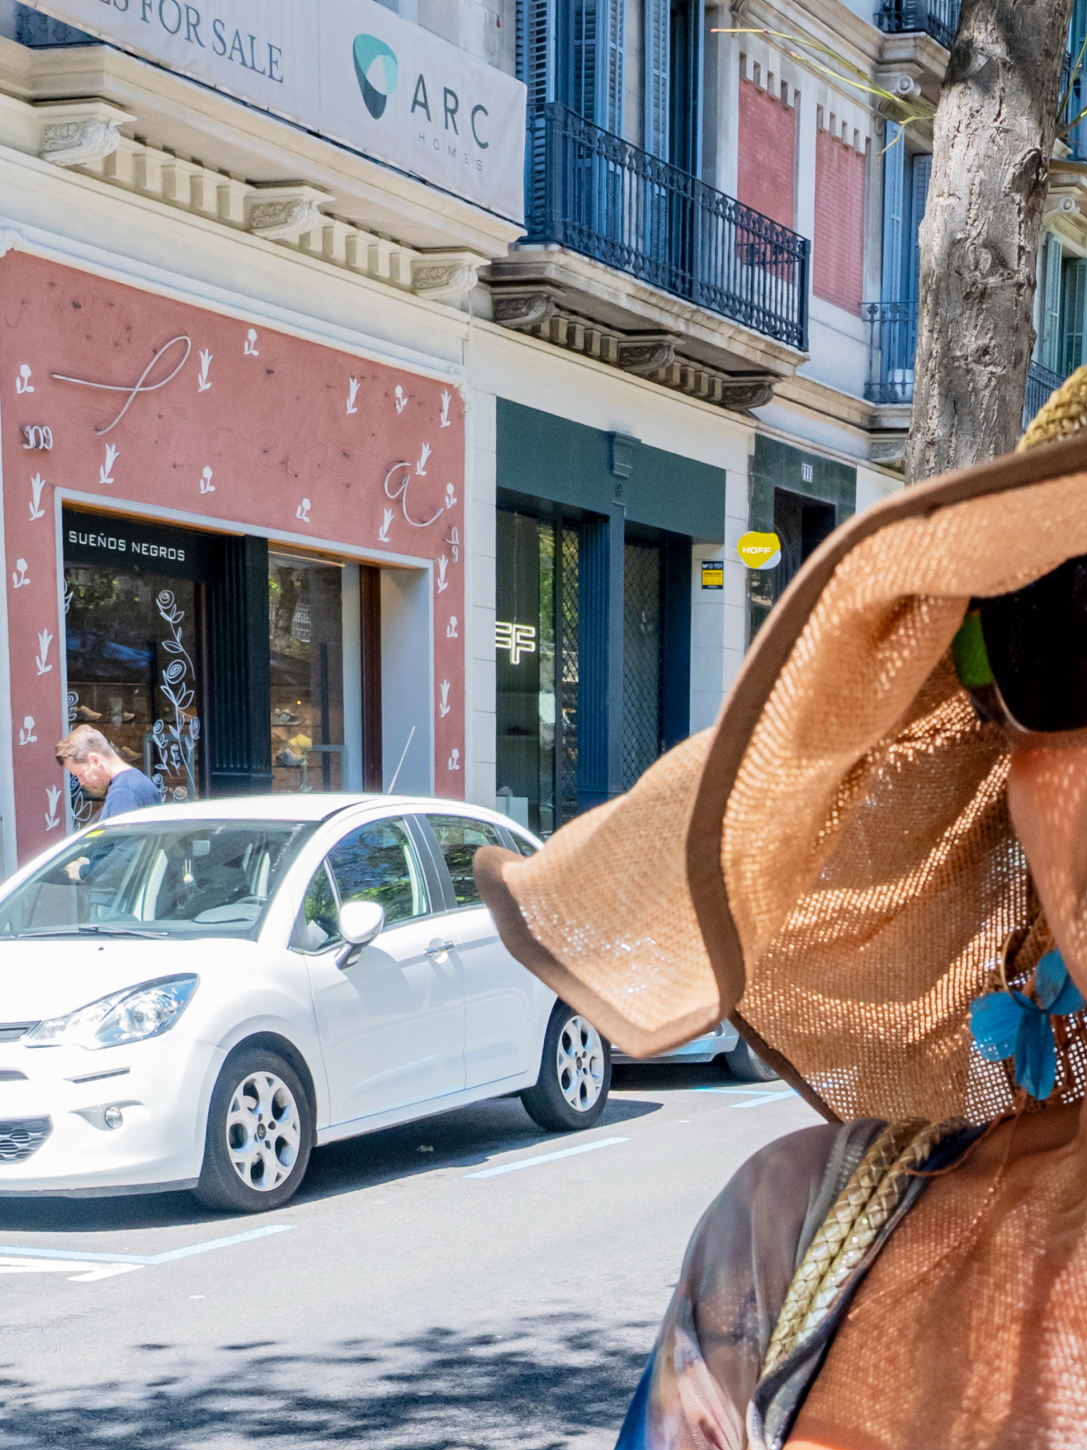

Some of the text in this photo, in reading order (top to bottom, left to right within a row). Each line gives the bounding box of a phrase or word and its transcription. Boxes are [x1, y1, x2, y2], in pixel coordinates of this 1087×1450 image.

[212, 18, 284, 84] SALE
[410, 73, 490, 150] ARC
[418, 130, 484, 173] HOMES
[69, 530, 186, 562] SUEÑOS NEGROS
[741, 546, 772, 555] HOFF
